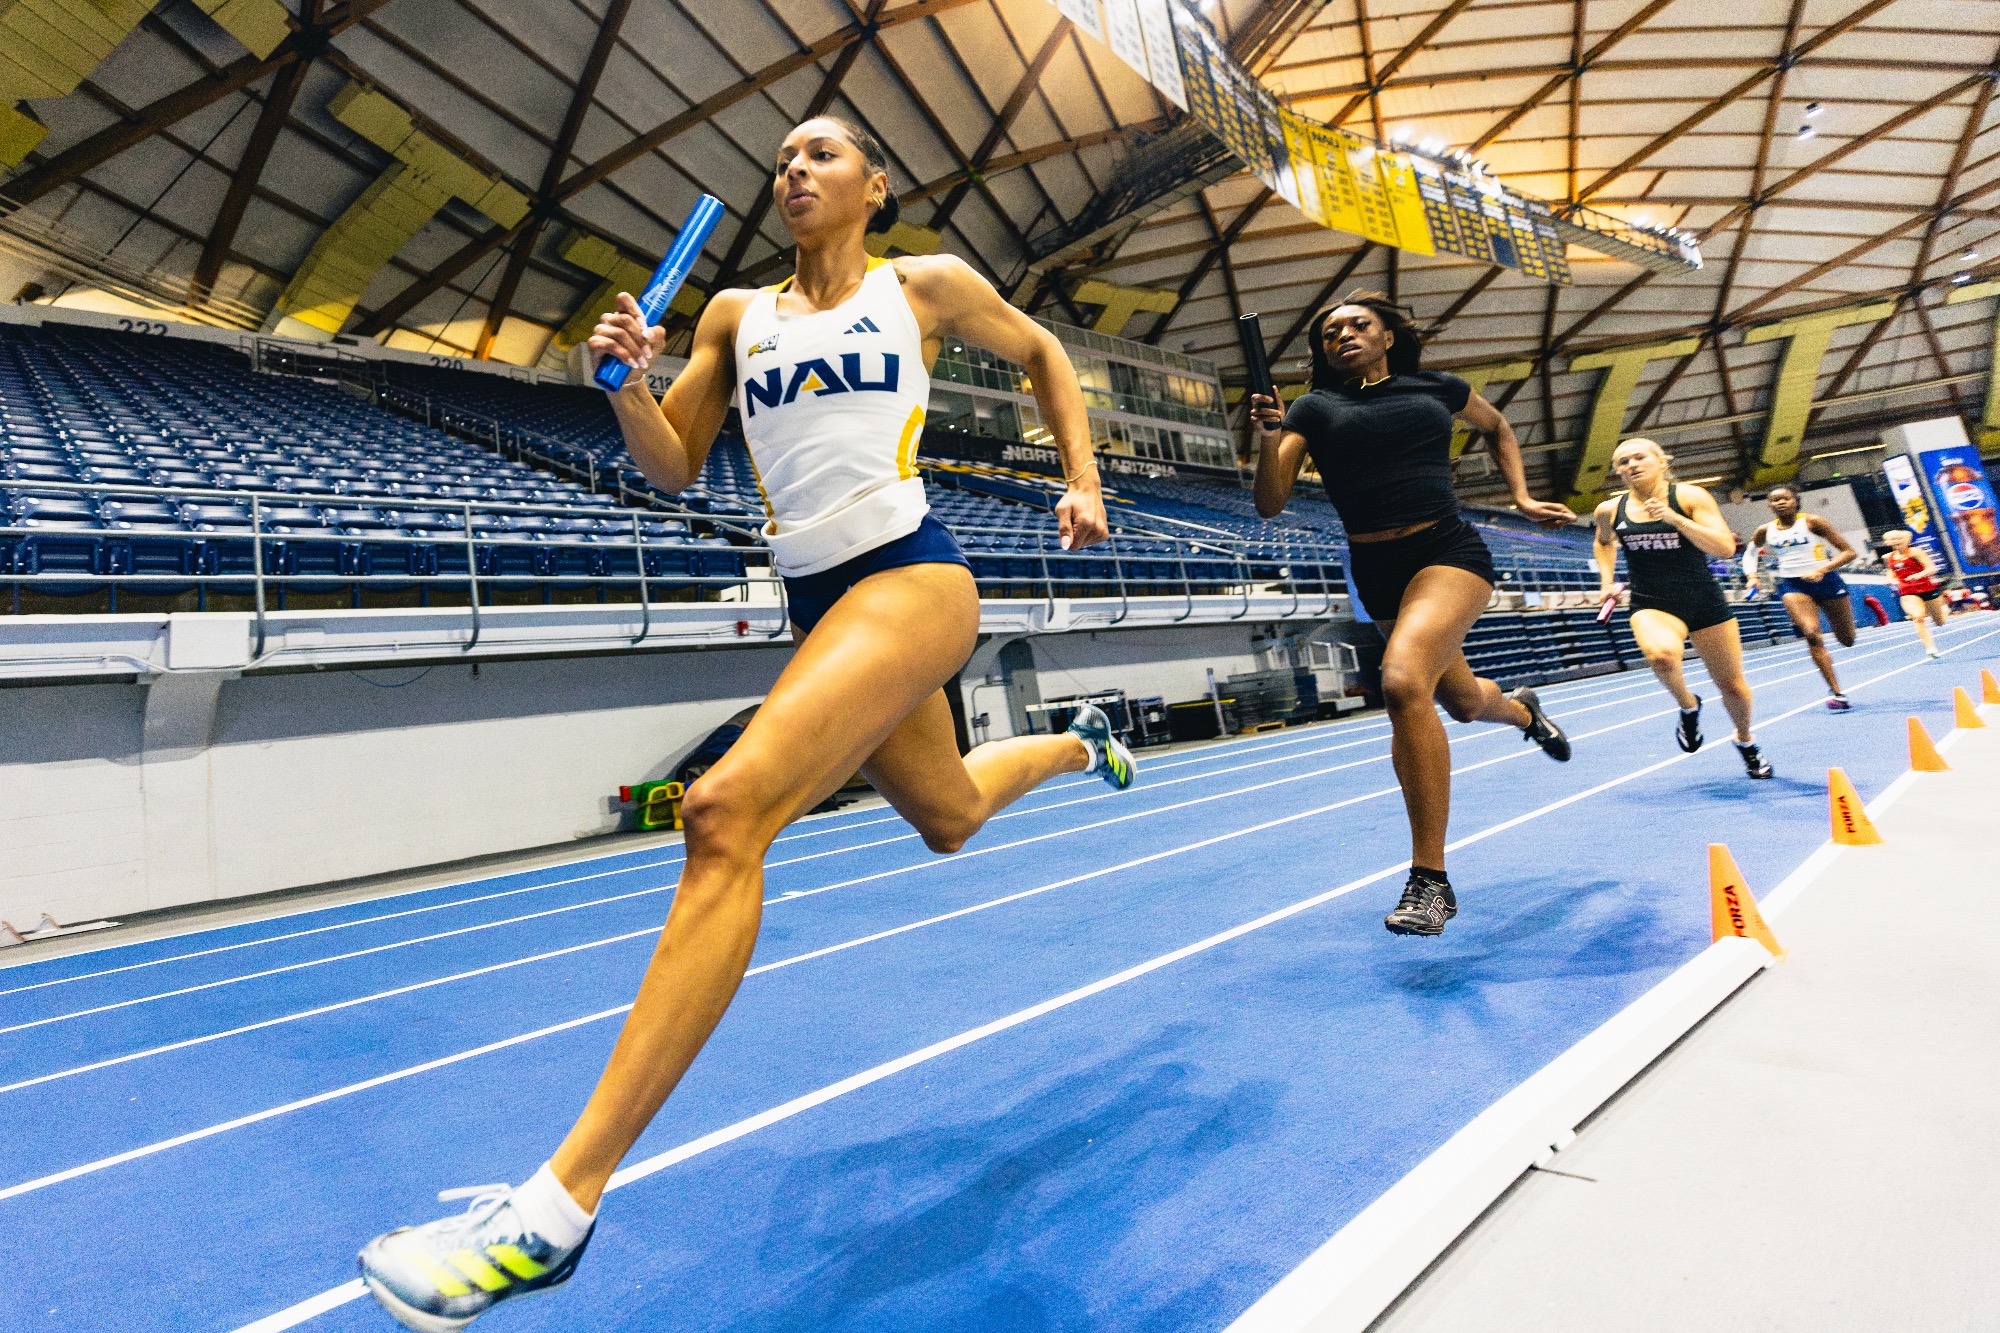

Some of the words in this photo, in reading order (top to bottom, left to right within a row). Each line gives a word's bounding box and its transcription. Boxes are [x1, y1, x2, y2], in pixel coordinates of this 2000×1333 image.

[118, 319, 169, 336] 222
[744, 352, 900, 419] NAU
[1626, 539, 1681, 551] UTAH
